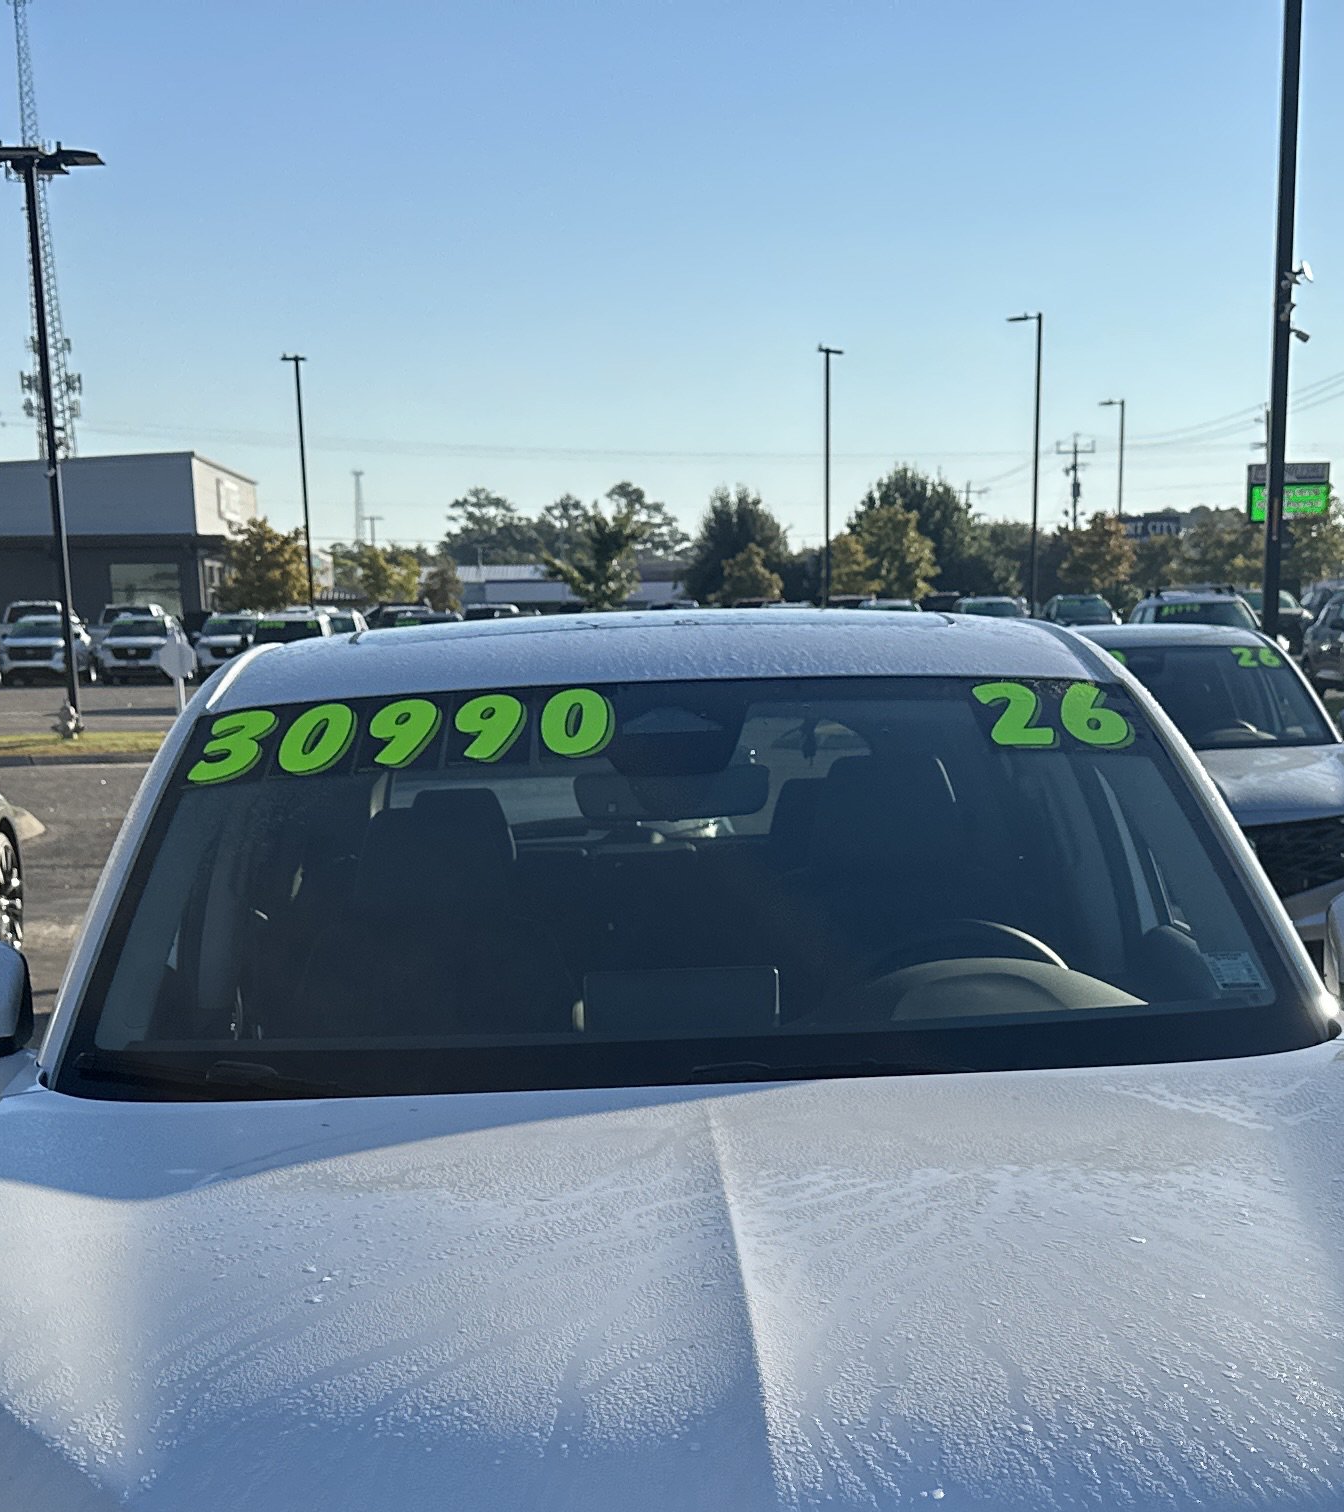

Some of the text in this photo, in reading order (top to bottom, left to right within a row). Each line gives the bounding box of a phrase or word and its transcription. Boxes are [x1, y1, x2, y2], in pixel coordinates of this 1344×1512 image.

[1231, 646, 1281, 668] 26
[187, 688, 615, 784] 30990
[972, 681, 1135, 749] 26
